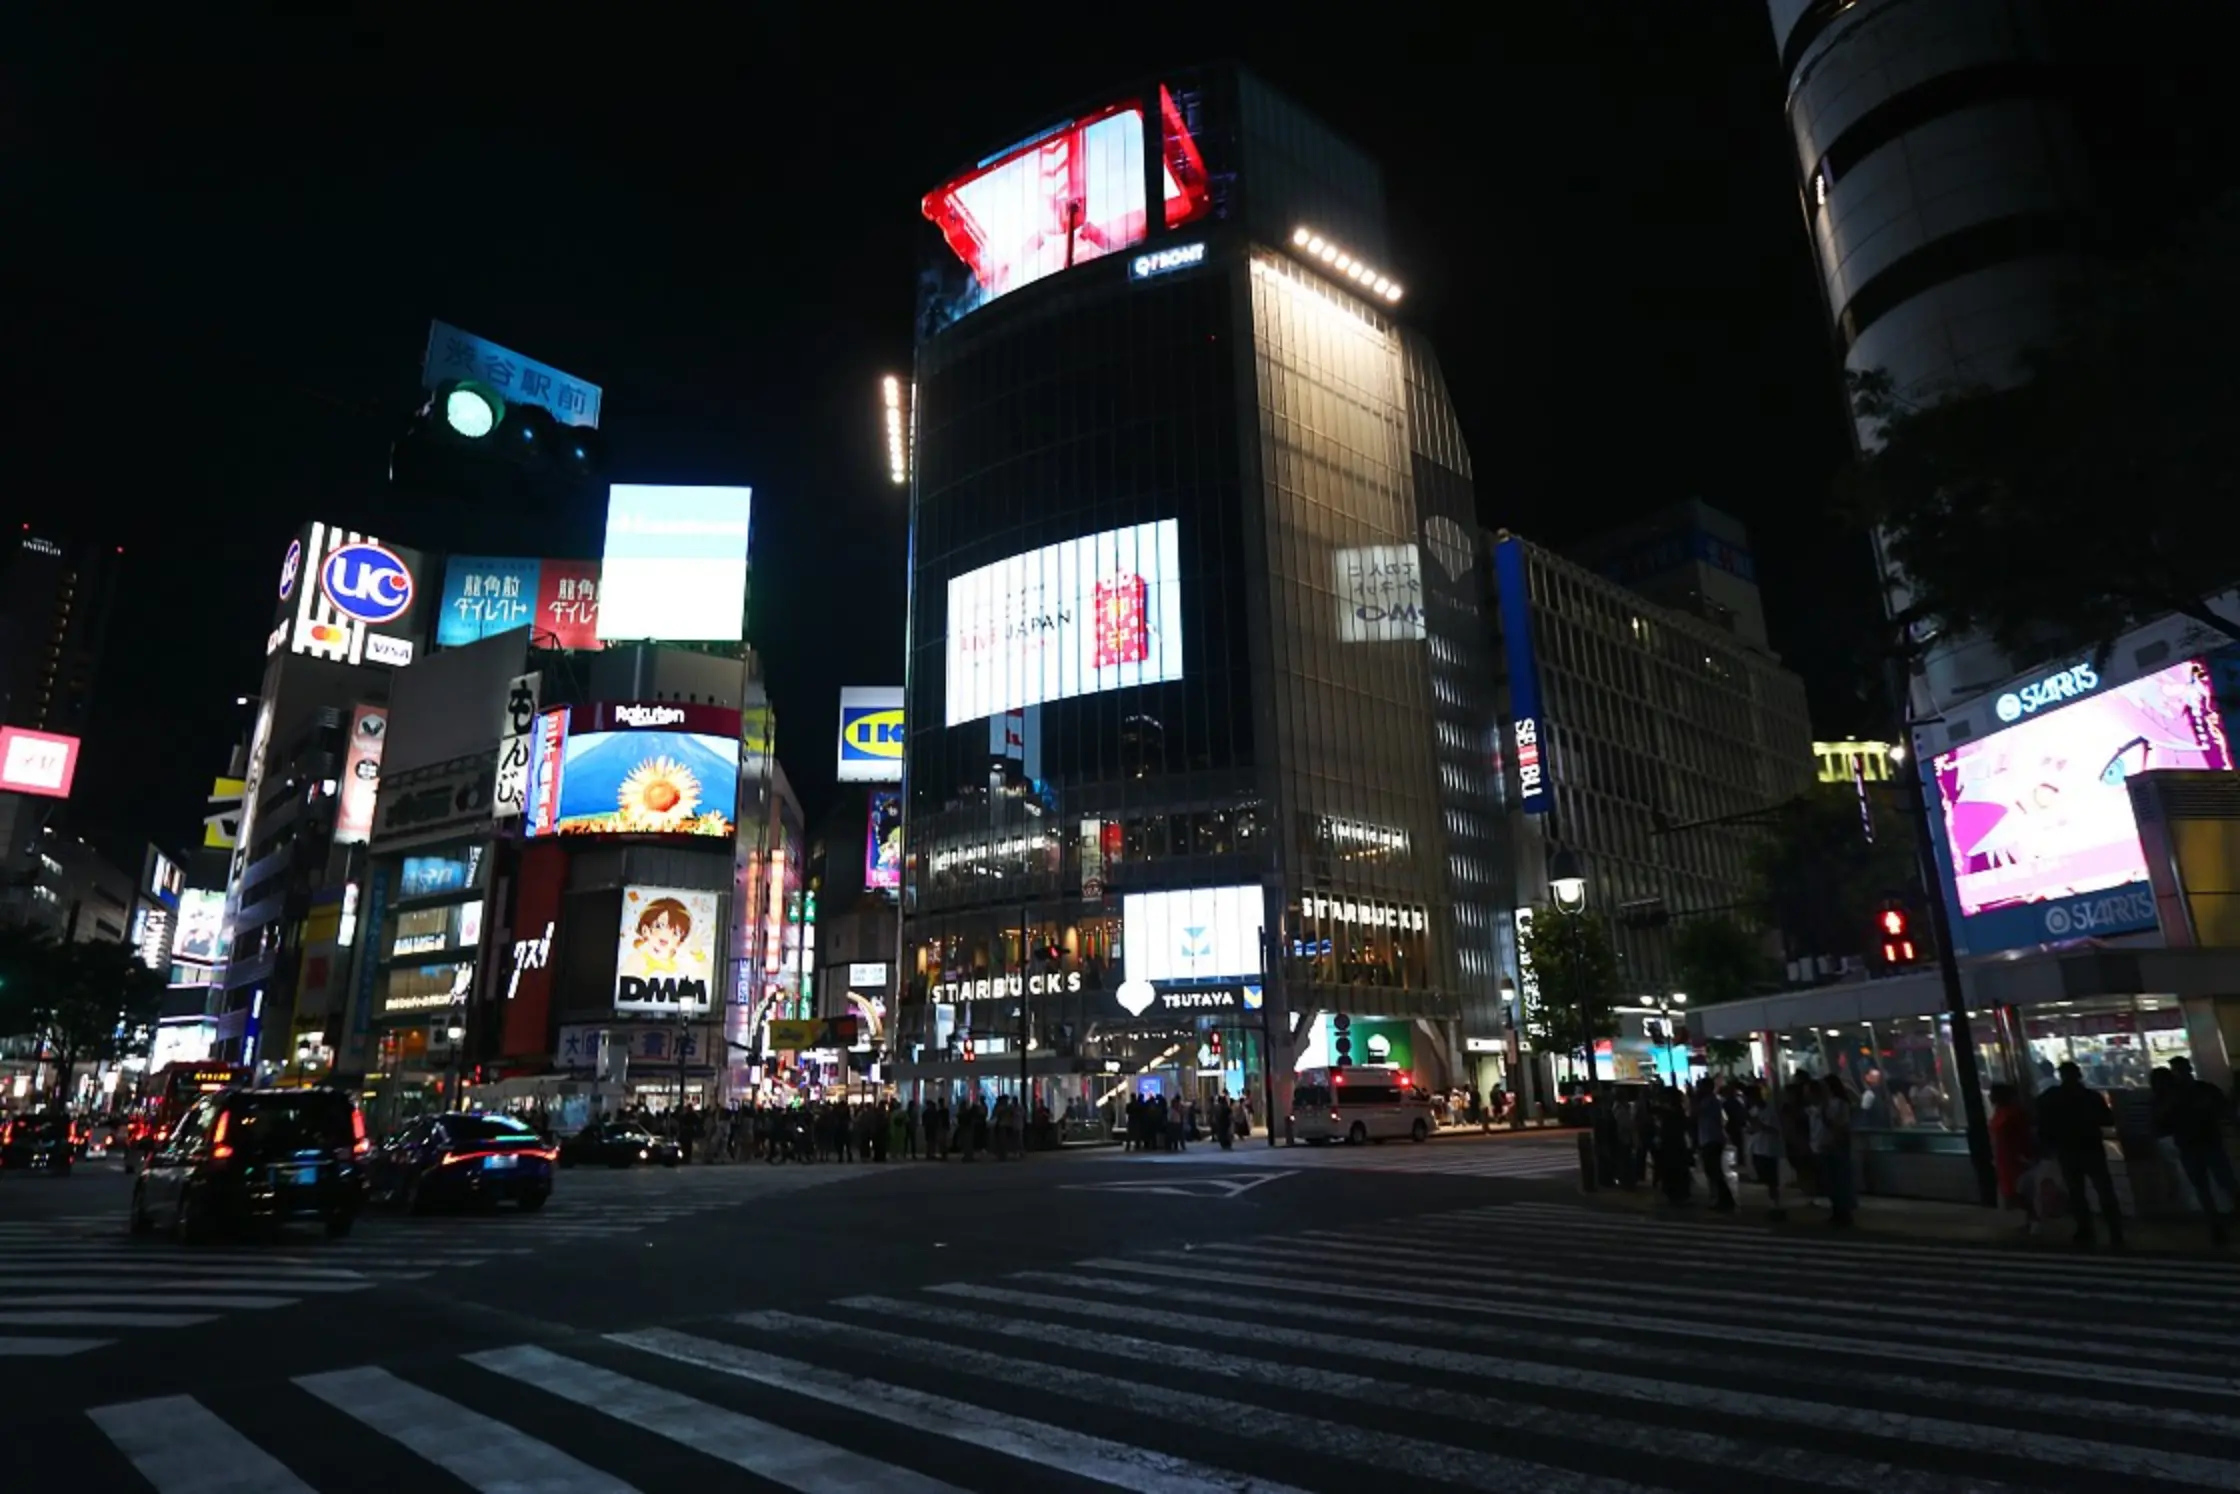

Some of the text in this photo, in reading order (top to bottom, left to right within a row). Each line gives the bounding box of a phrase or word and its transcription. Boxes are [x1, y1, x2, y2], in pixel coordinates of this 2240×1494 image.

[446, 338, 586, 415] 渋谷駅前
[332, 556, 405, 607] UC
[557, 577, 601, 601] 龍角
[453, 597, 528, 622] ダイレクト
[615, 704, 685, 727] Rakuten
[1515, 718, 1542, 799] SEIBU
[1302, 897, 1424, 932] STARBUCKS
[618, 974, 707, 1005] DMM
[932, 971, 1081, 1004] STARBUCKS
[1162, 991, 1234, 1009] TSUTAYA
